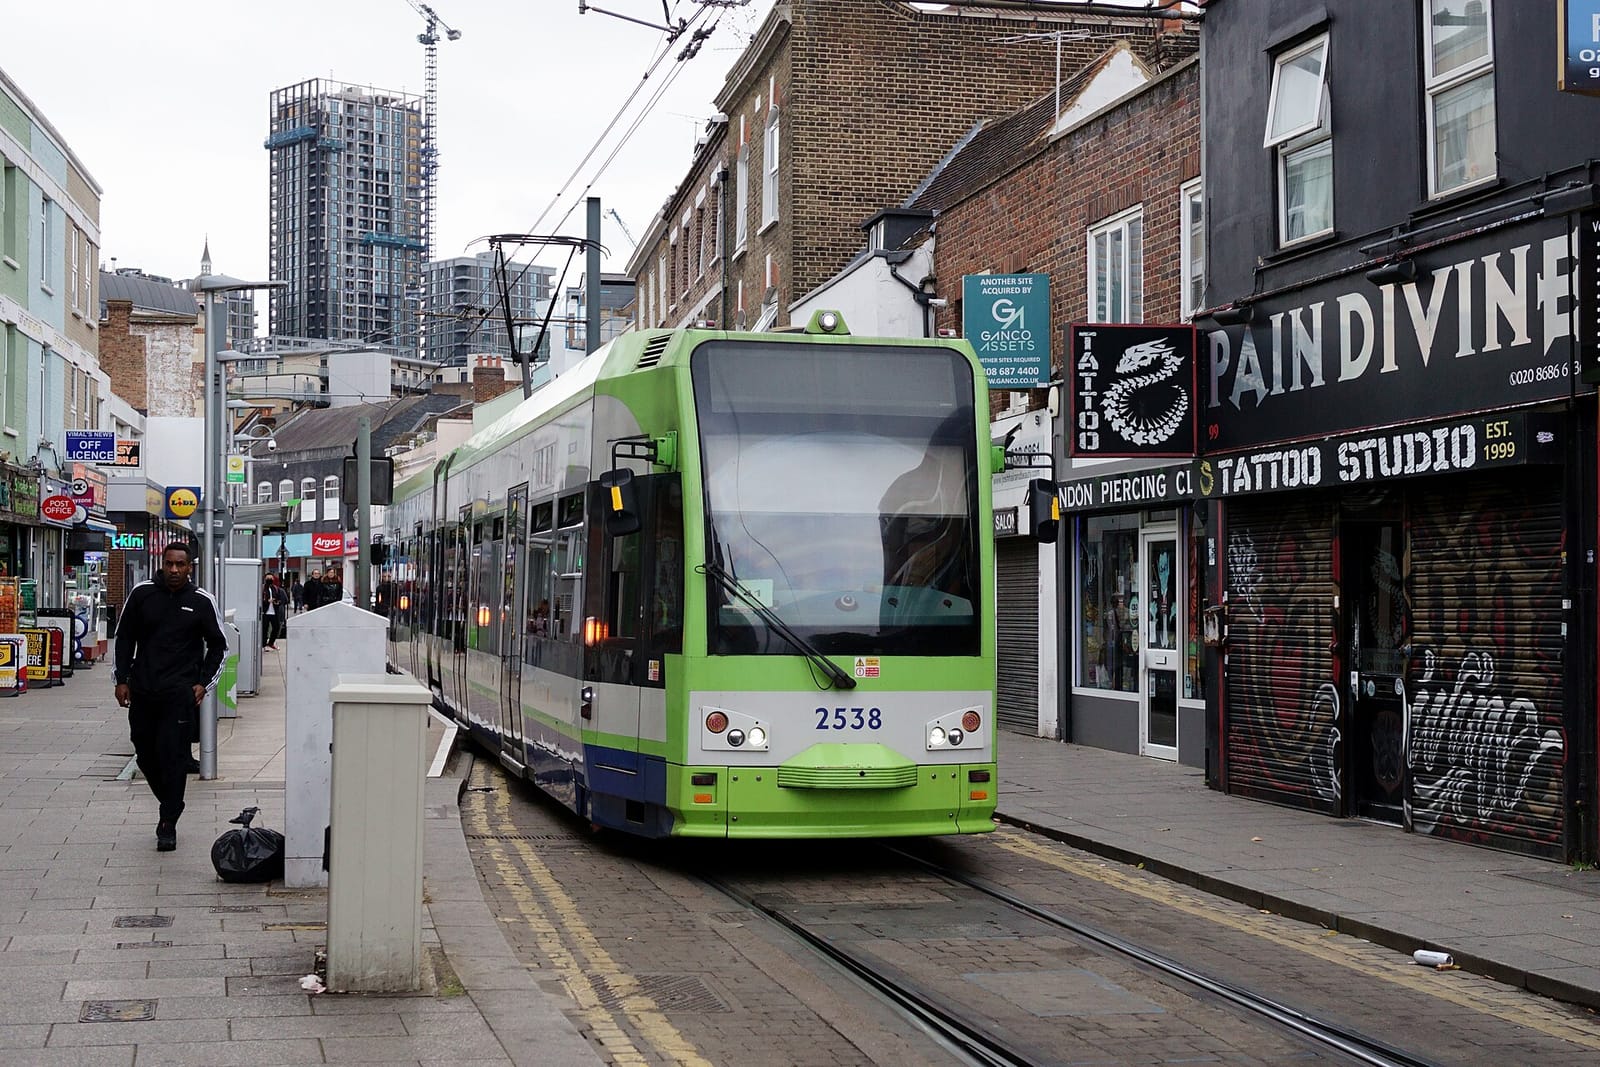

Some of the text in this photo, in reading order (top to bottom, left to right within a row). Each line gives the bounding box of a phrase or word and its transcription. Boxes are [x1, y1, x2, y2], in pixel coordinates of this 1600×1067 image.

[980, 277, 1033, 286] ANOTHER SITE
[982, 286, 1032, 295] ACQUIRED BY
[980, 330, 1031, 341] GANCO
[980, 340, 1035, 352] ASSETS
[999, 367, 1015, 376] 687
[1017, 366, 1039, 375] 4400
[1516, 368, 1534, 385] 020
[1535, 363, 1560, 381] 8686
[1077, 331, 1099, 450] TATTOO
[1208, 423, 1219, 440] 99
[1485, 420, 1513, 439] EST.
[79, 440, 102, 450] OFF
[66, 450, 114, 460] LICENCE
[1483, 441, 1516, 461] 1999
[1217, 424, 1477, 495] TATTOO STUDIO
[1058, 482, 1093, 509] NDON
[1101, 473, 1167, 504] PIERCING
[49, 500, 69, 508] POST
[45, 506, 73, 515] OFFICE
[314, 537, 341, 548] Argos
[27, 655, 42, 666] ERE
[815, 707, 882, 730] 2538
